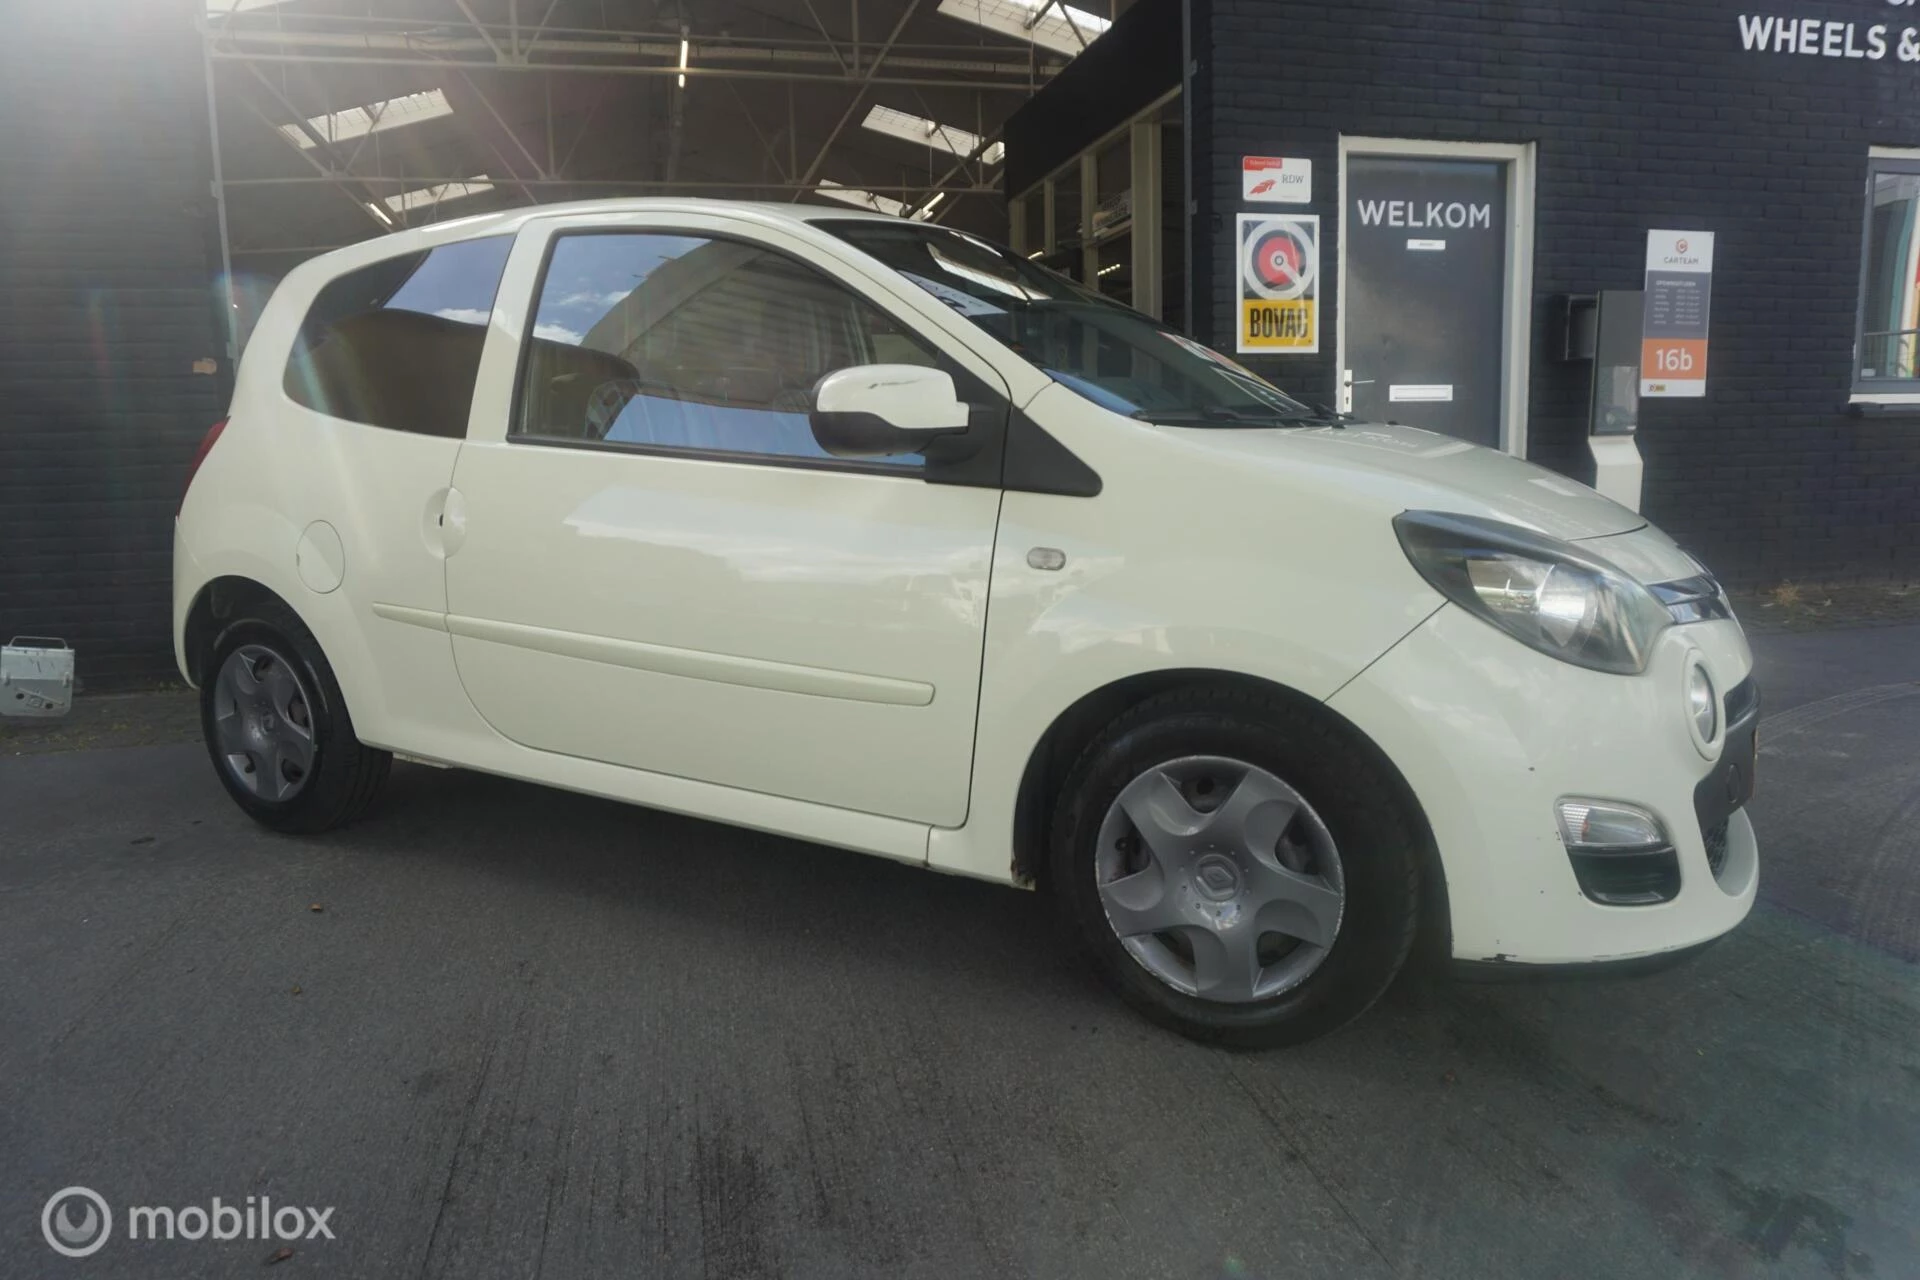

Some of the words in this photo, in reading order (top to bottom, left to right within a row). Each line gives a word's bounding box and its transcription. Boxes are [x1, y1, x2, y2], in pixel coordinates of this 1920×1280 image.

[1738, 14, 1887, 60] WHEELS
[1897, 27, 1920, 62] &
[1281, 173, 1305, 185] RDW
[1357, 199, 1491, 229] WELKOM
[1655, 347, 1693, 372] 16b
